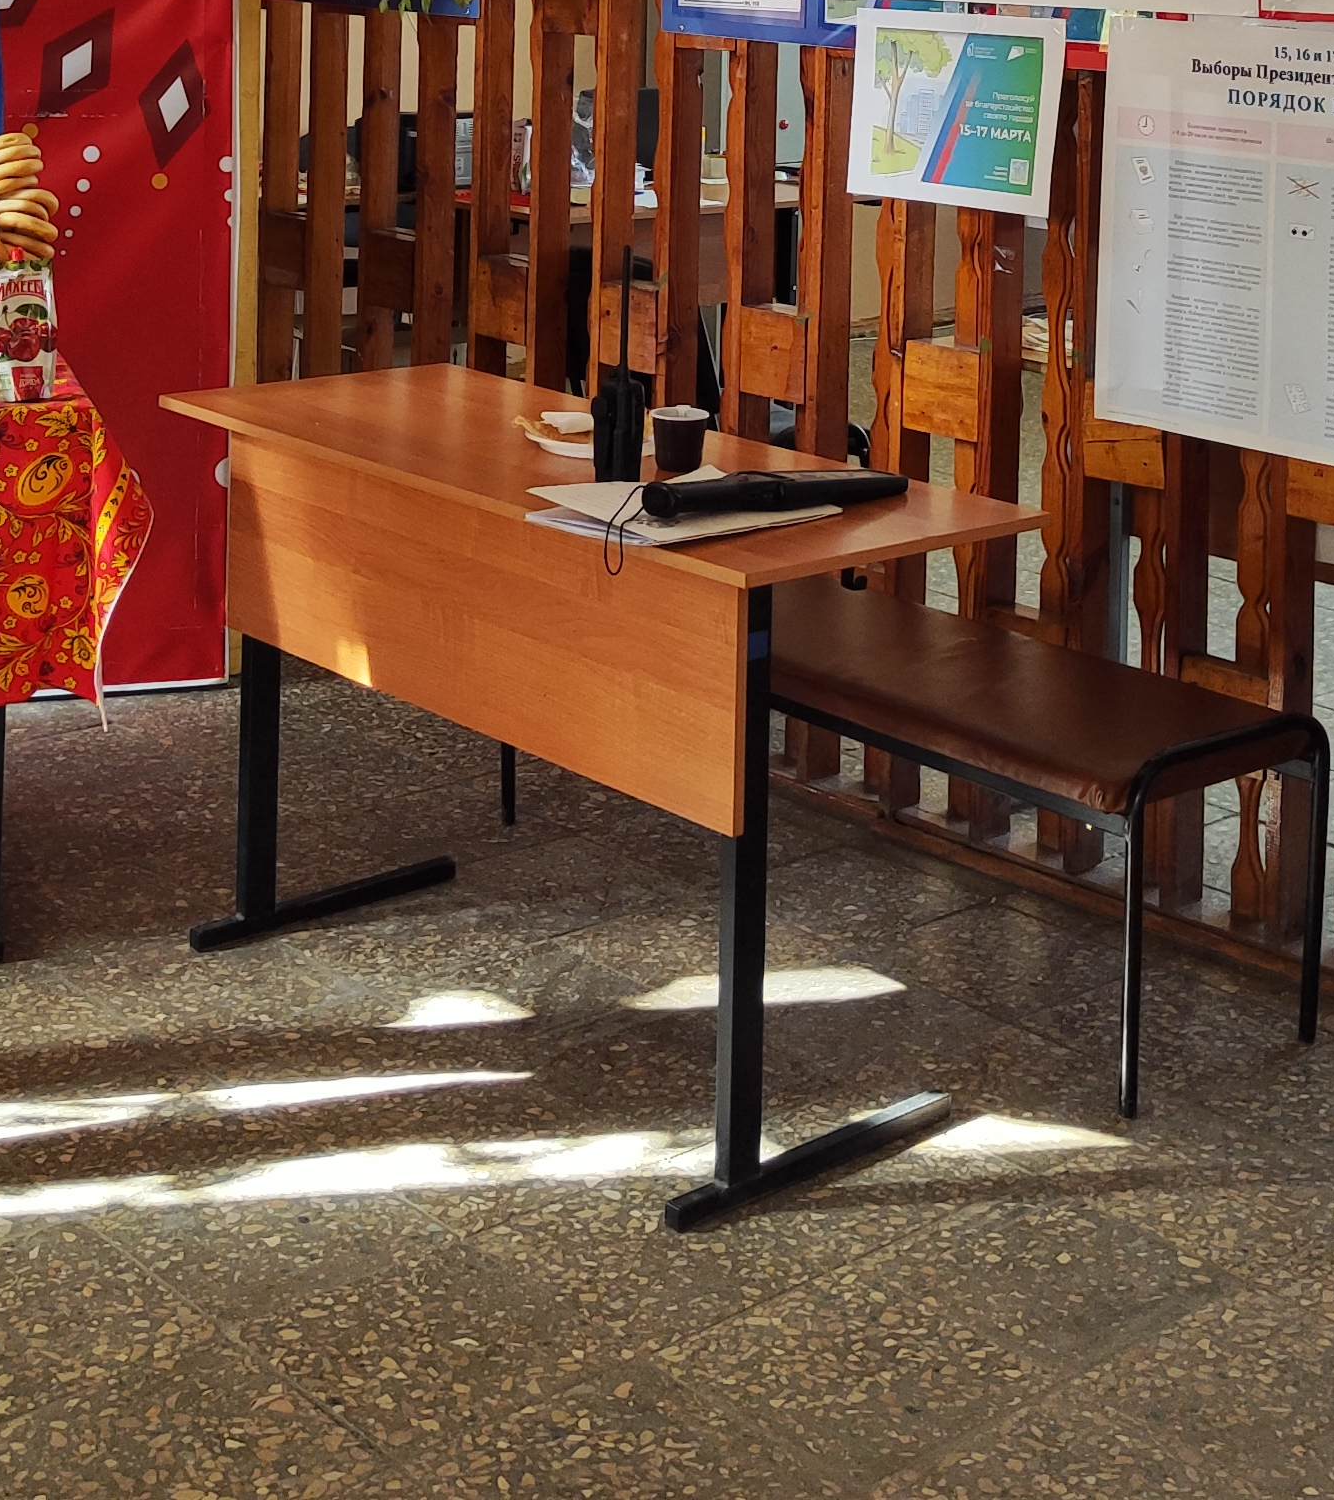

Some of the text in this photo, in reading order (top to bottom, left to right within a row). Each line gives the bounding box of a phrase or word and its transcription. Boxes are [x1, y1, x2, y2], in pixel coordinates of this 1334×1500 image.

[1274, 46, 1292, 61] 15,
[1296, 48, 1310, 61] 16
[1313, 52, 1322, 61] и
[1191, 58, 1252, 79] Выборы
[1227, 88, 1326, 114] ПОРЯДОК
[959, 123, 1032, 143] 15-17 МАРТА
